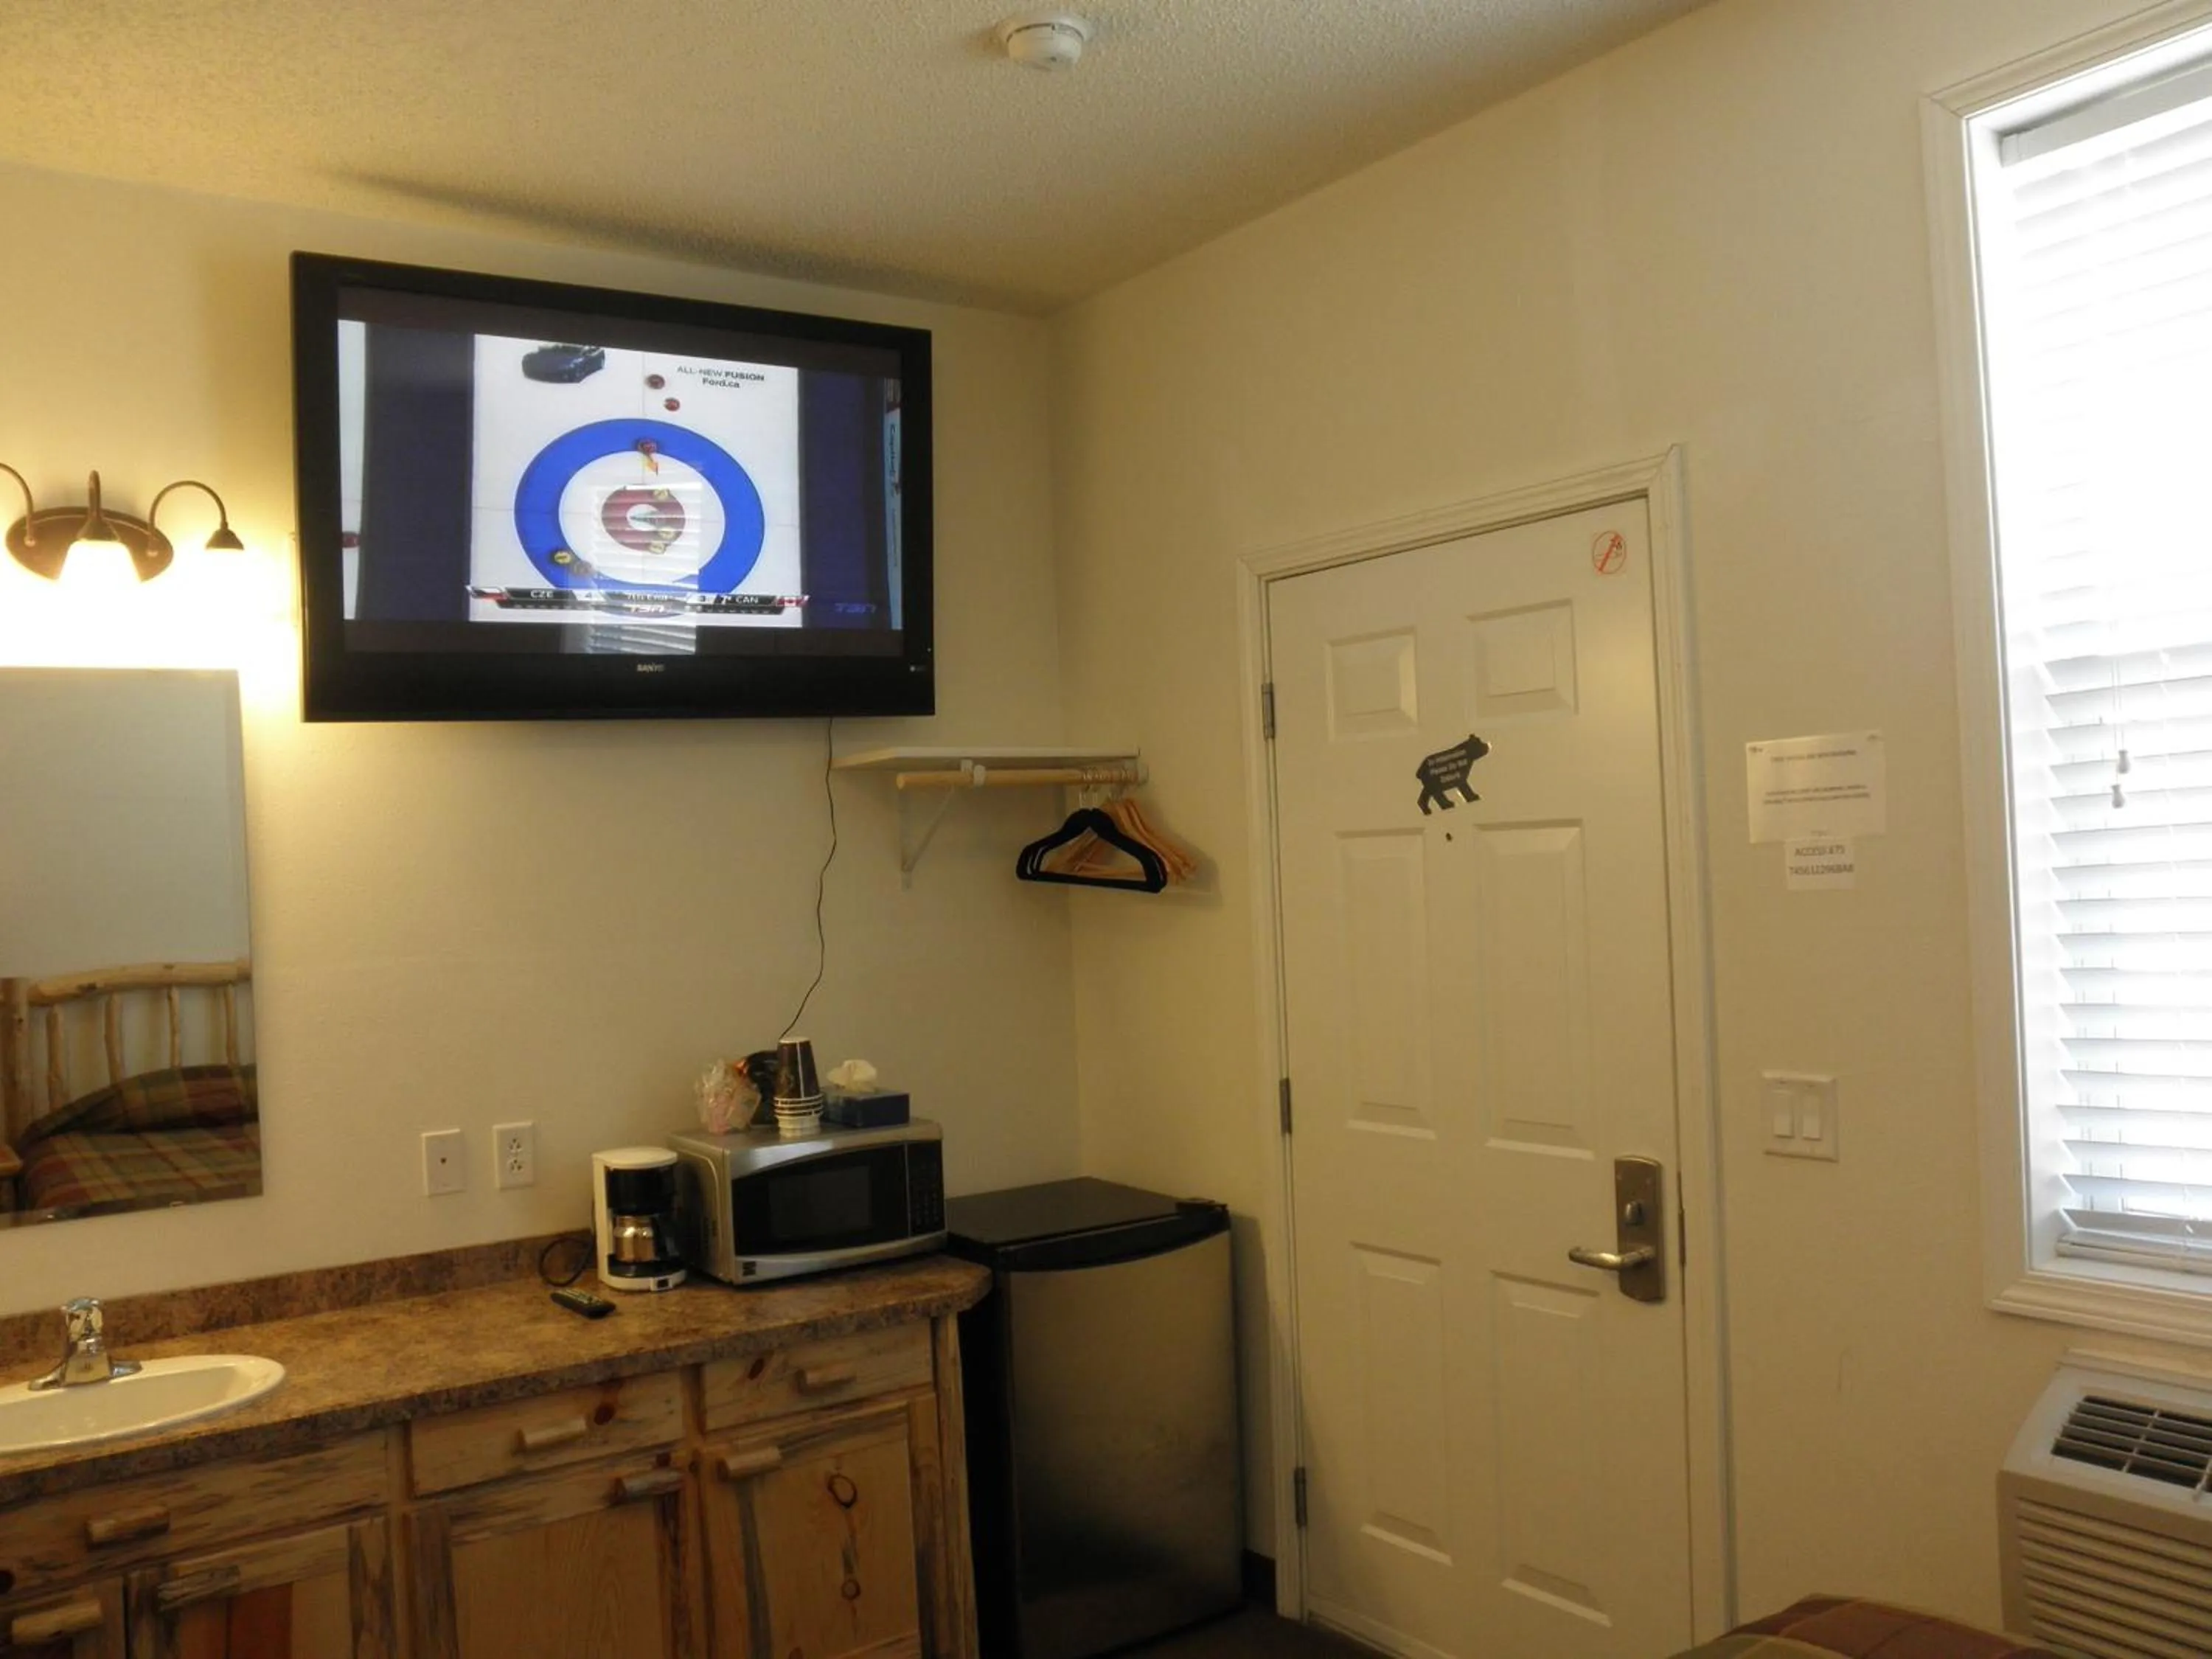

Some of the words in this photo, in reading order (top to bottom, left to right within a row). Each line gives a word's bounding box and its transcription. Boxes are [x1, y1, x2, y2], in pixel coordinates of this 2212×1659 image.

[725, 371, 765, 381] FUSION
[703, 377, 740, 388] Ford.ca
[530, 589, 554, 599] CZE
[735, 595, 759, 604] CAN
